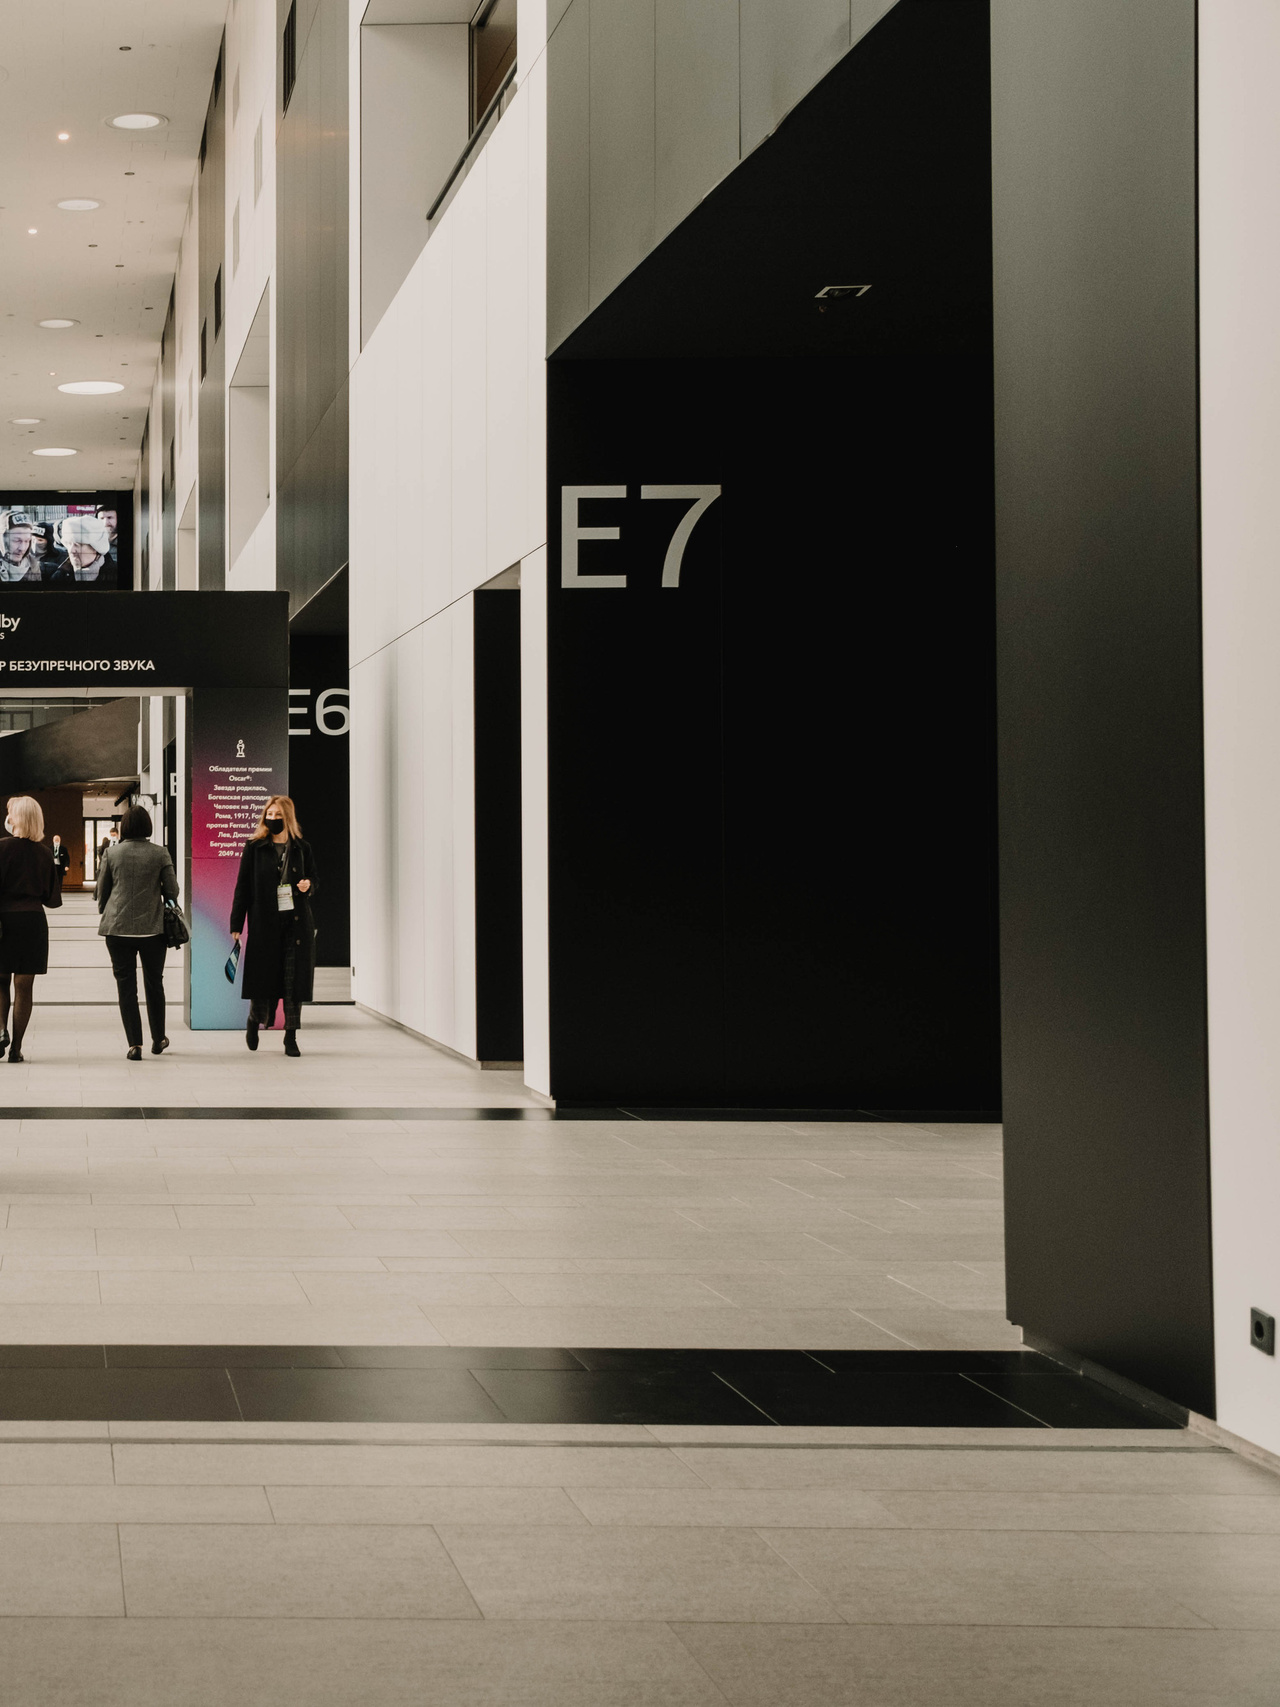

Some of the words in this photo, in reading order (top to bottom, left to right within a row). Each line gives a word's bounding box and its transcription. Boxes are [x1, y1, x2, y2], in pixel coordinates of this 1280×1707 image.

[561, 484, 722, 589] E7
[9, 660, 111, 671] БЕЗУПРЕЧНОГО
[113, 659, 156, 671] ЗВУКА
[288, 688, 350, 736] E6
[209, 765, 247, 773] Обладатели
[215, 812, 233, 820] Рома,
[234, 812, 251, 820] 1917,
[217, 831, 232, 839] Лев,
[210, 840, 237, 849] Бегущий
